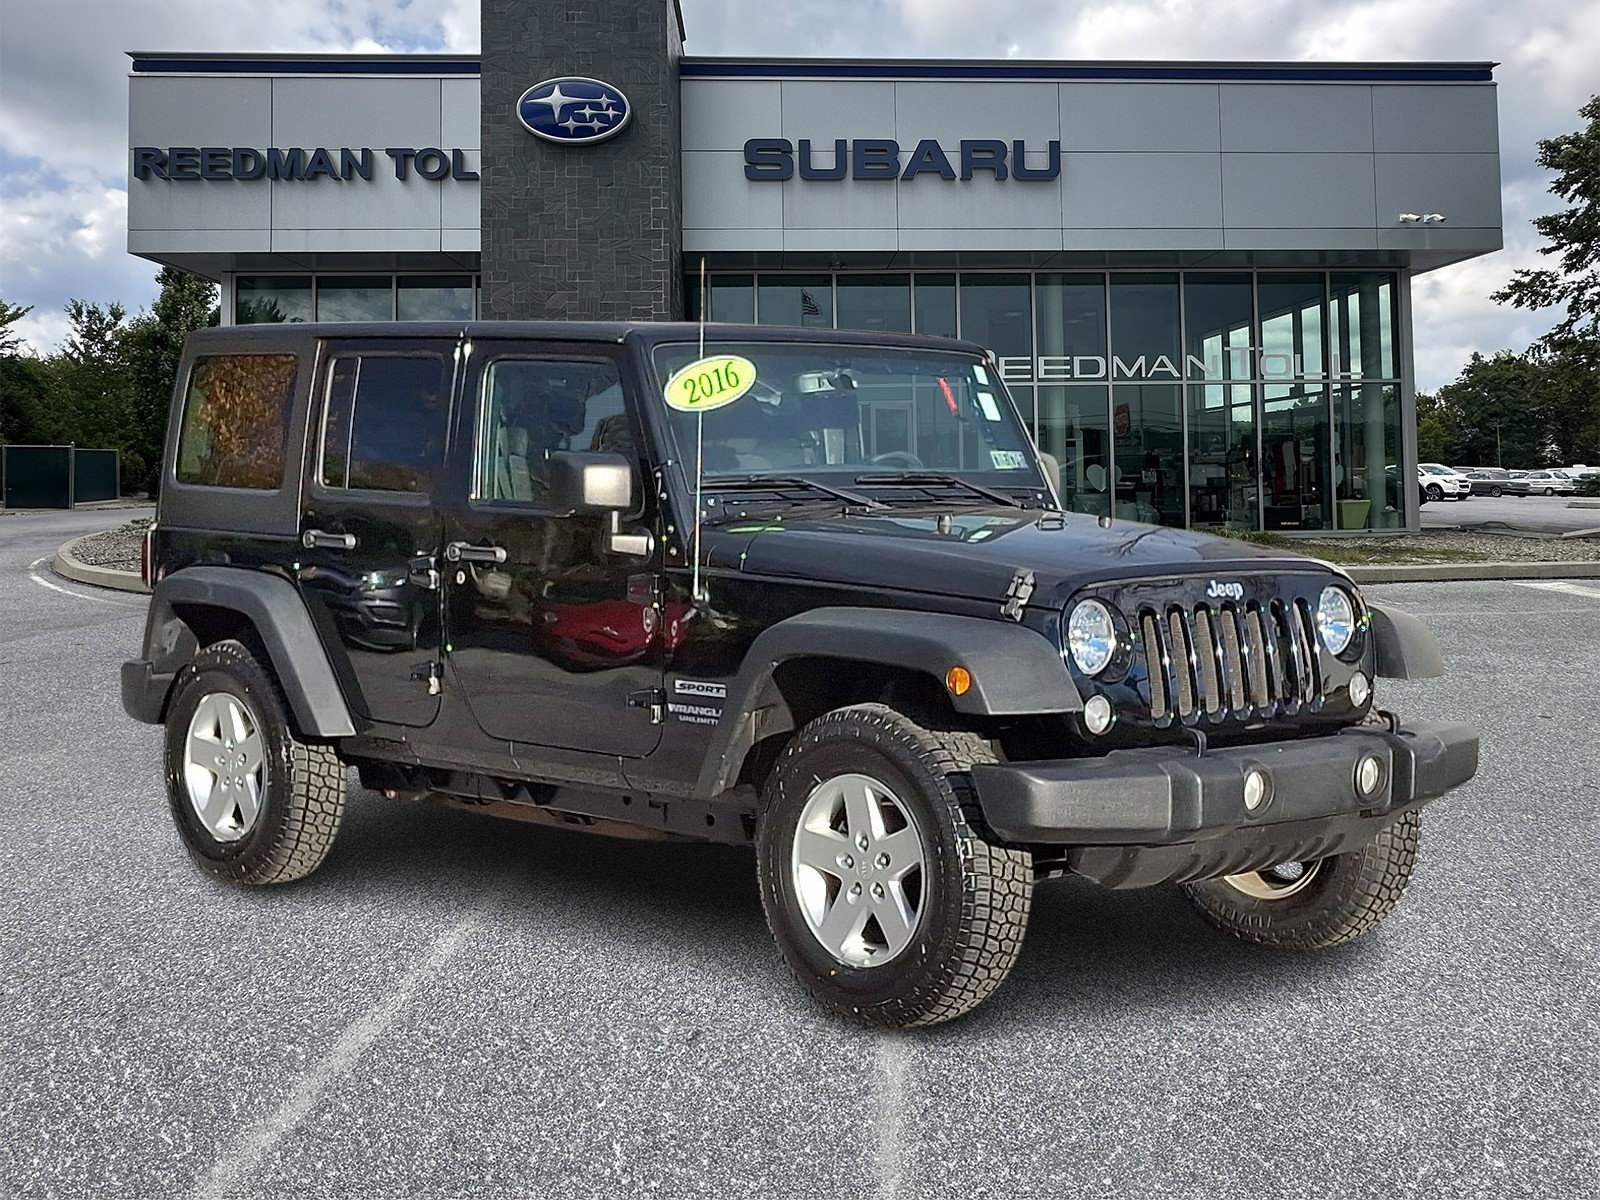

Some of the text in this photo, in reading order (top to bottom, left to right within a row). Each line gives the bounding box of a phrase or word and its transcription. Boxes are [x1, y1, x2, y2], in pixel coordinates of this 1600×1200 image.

[133, 147, 373, 181] REEDMAN
[743, 138, 1062, 181] SUBARU
[683, 361, 739, 404] 2016
[1206, 579, 1244, 601] Jeep
[678, 682, 725, 694] SPORT
